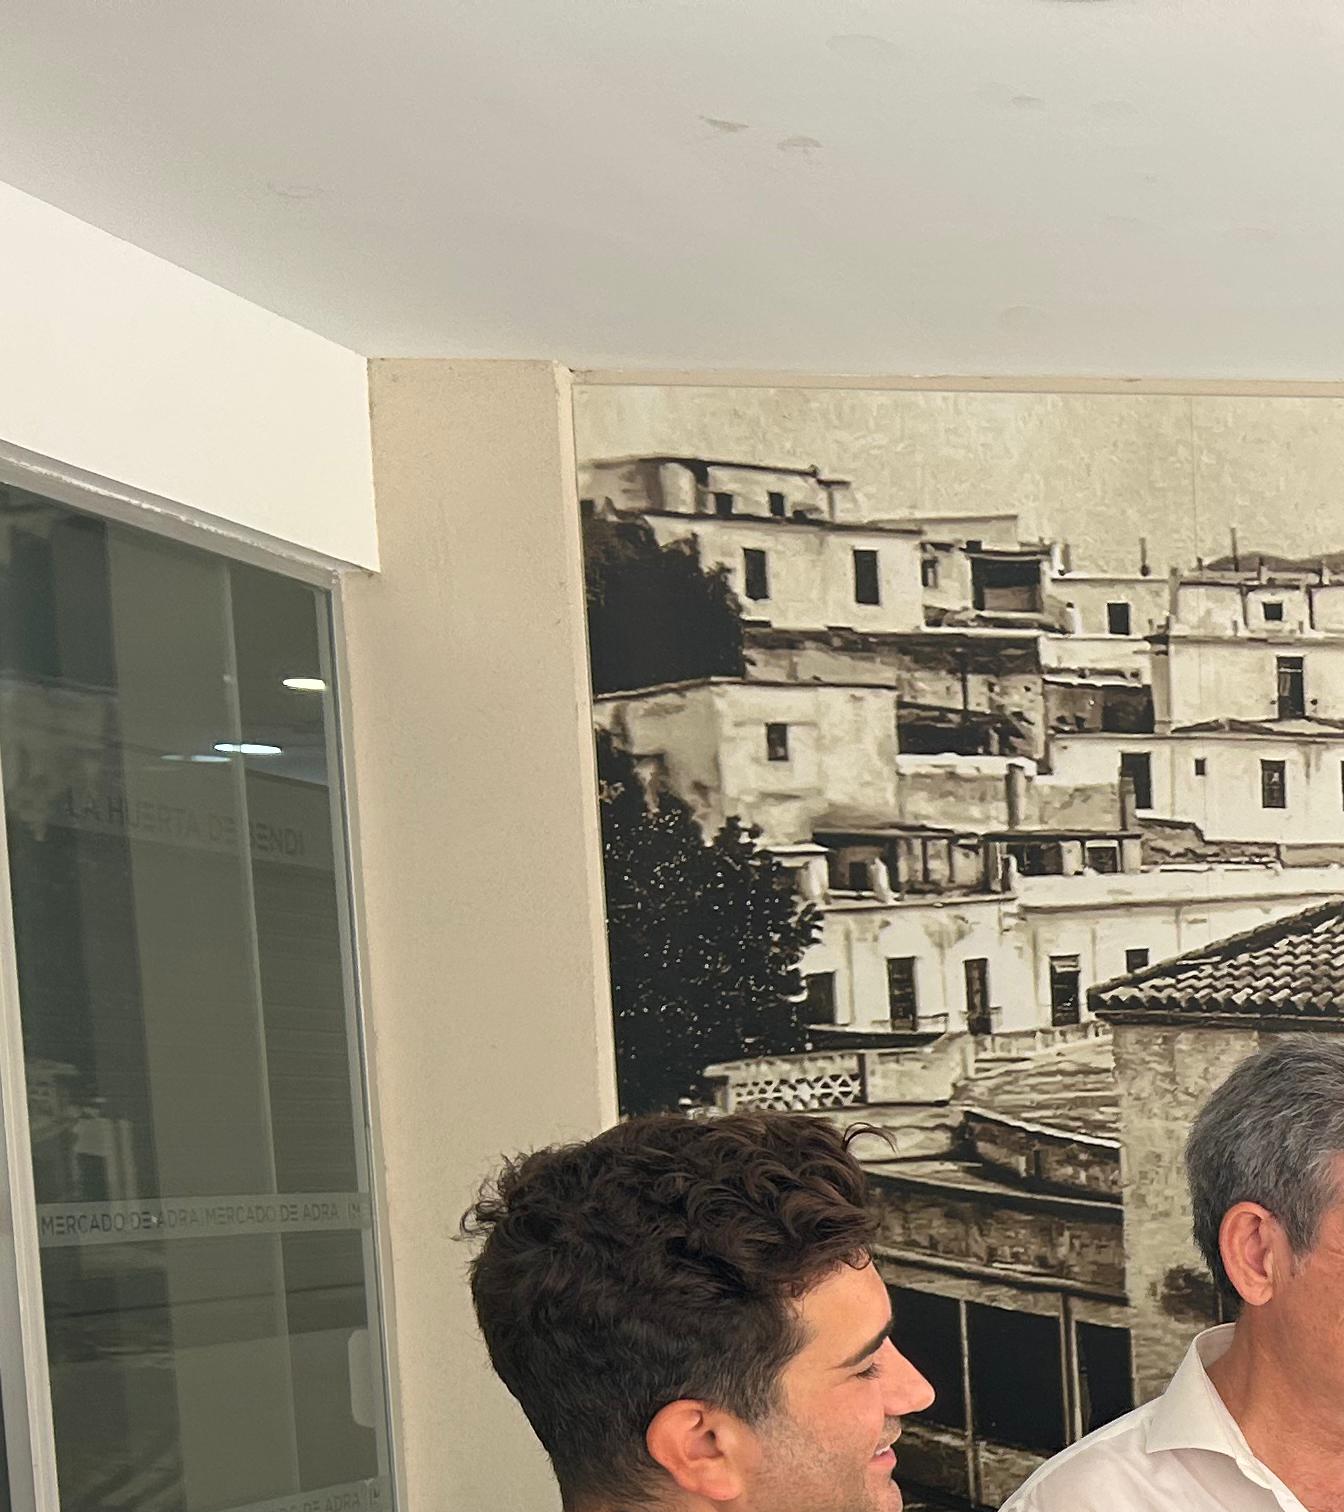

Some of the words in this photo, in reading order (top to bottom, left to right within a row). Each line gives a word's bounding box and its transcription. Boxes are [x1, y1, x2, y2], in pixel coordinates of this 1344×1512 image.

[41, 1211, 124, 1235] MERCADO
[130, 1210, 152, 1230] DE
[155, 1207, 198, 1228] ADRA
[204, 1204, 275, 1226] MERCADO
[280, 1204, 299, 1221] DE
[301, 1201, 339, 1220] ADRA
[324, 1493, 361, 1512] ADRA
